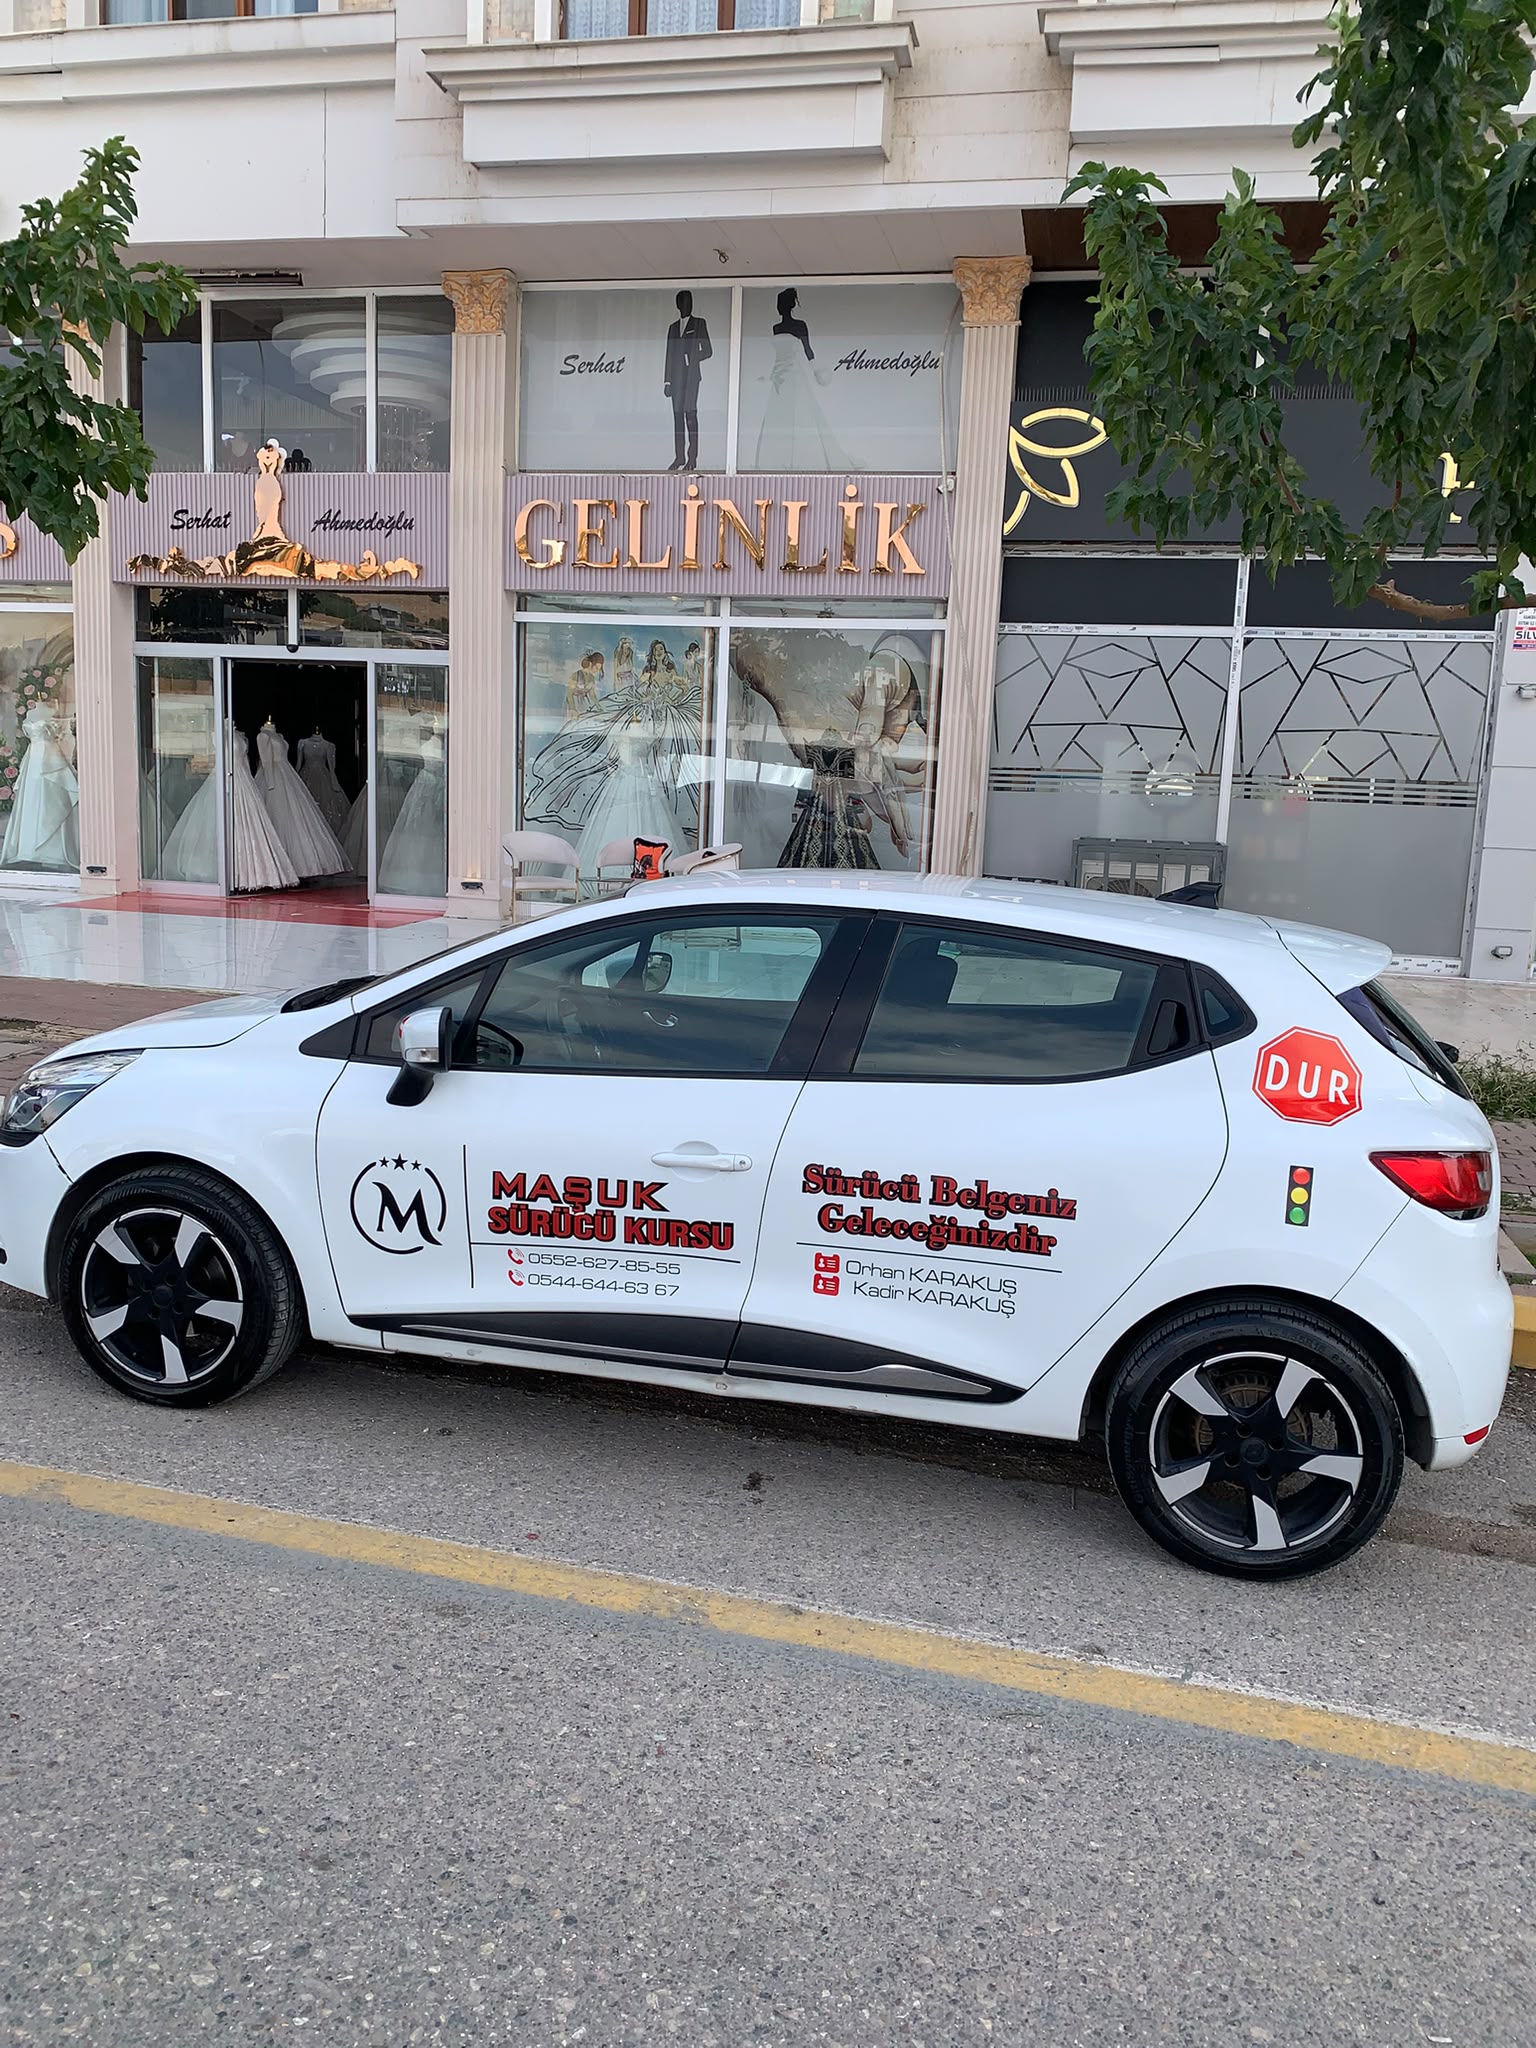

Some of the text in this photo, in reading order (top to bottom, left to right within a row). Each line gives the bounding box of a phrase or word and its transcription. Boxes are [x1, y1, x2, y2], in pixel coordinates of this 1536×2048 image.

[559, 349, 942, 377] Serhat Ahmedoğlu
[170, 508, 416, 538] Serhat Ahmedoğlu
[514, 483, 927, 576] GELİNLİK
[1265, 1053, 1350, 1106] DUR
[372, 1181, 443, 1246] M
[492, 1170, 671, 1214] MAŞUK
[801, 1163, 1077, 1220] Sürücü Belgeniz
[488, 1203, 735, 1251] SÜRÜCÜ KURSU
[817, 1203, 1057, 1256] Geleceğinizdir
[527, 1273, 680, 1297] 0544-644-63 67
[528, 1253, 681, 1275] 0552-627-85-55
[845, 1260, 1018, 1299] Orhan KARAKUŞ
[853, 1281, 1016, 1319] Kadir KARAKUŞ
